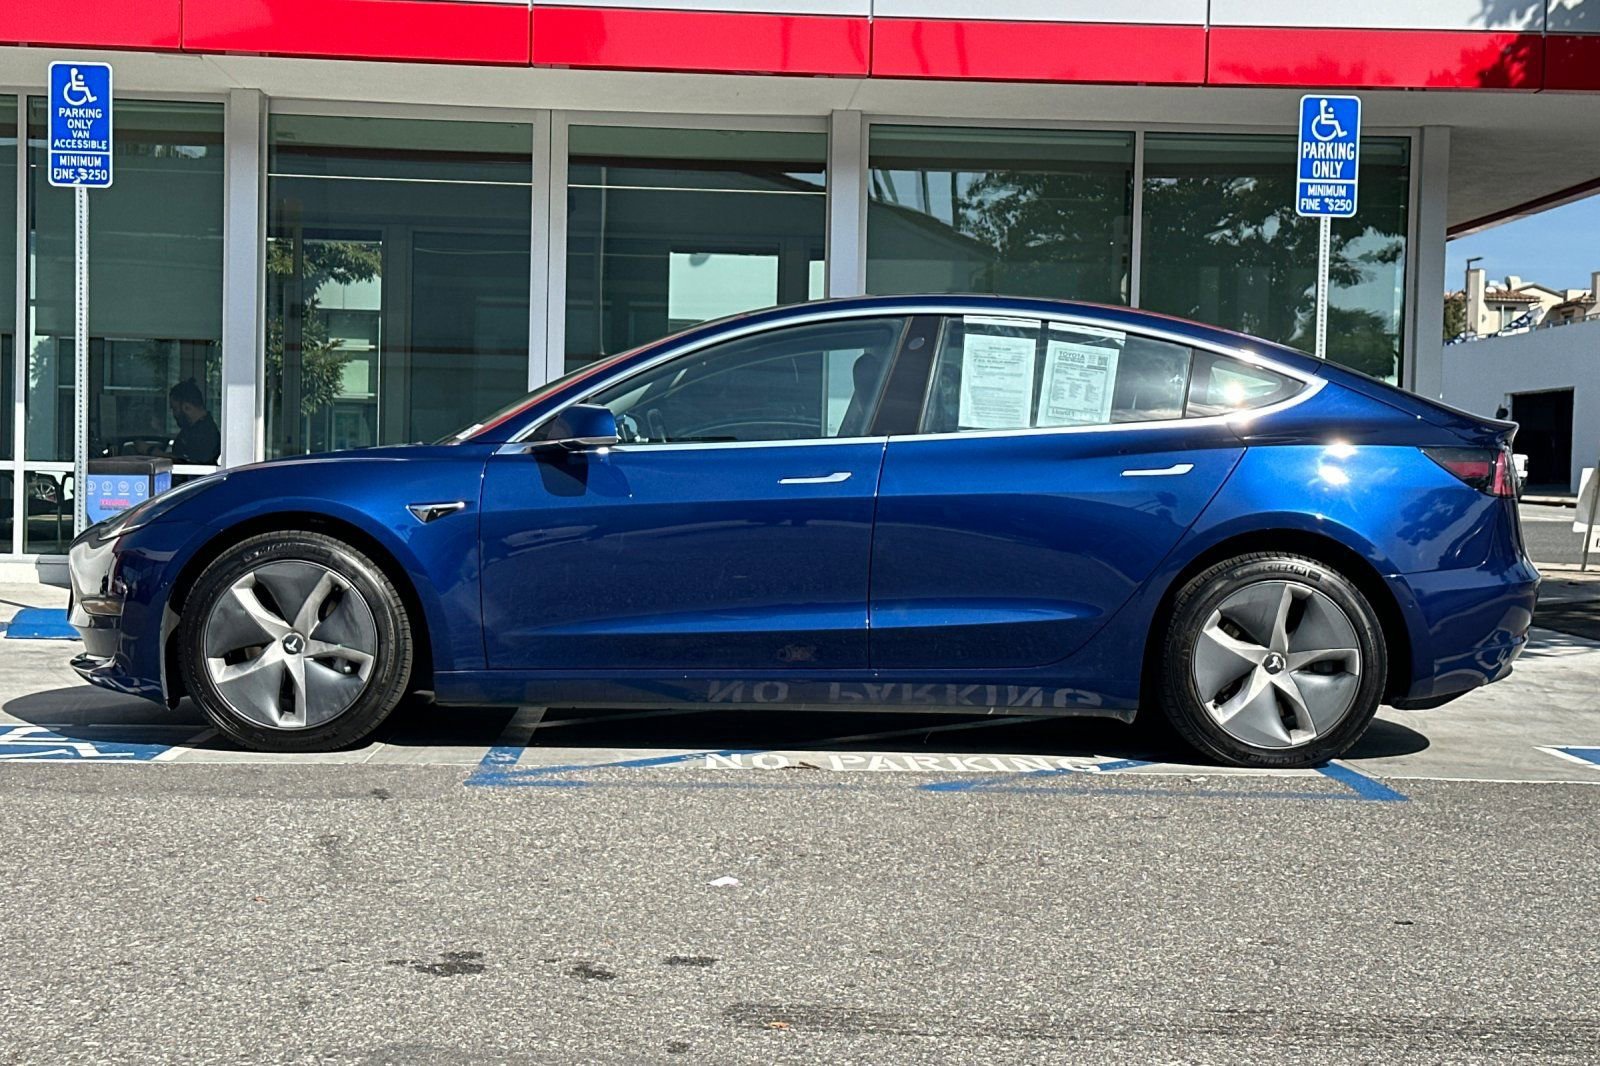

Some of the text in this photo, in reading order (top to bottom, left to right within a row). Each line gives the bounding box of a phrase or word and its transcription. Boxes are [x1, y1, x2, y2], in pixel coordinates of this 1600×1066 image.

[58, 108, 102, 118] PARKING
[67, 119, 93, 129] ONLY
[72, 130, 89, 138] VAN
[54, 139, 107, 150] ACCESSIBLE
[1302, 142, 1355, 160] PARKING
[59, 155, 101, 167] MINIMUM
[54, 168, 107, 180] FINE $250
[1312, 161, 1344, 179] ONLY
[1307, 184, 1347, 197] MINIMUM
[1300, 198, 1352, 212] FINE $250
[1058, 351, 1085, 359] TOYOTA
[705, 753, 1101, 773] NO PARKING
